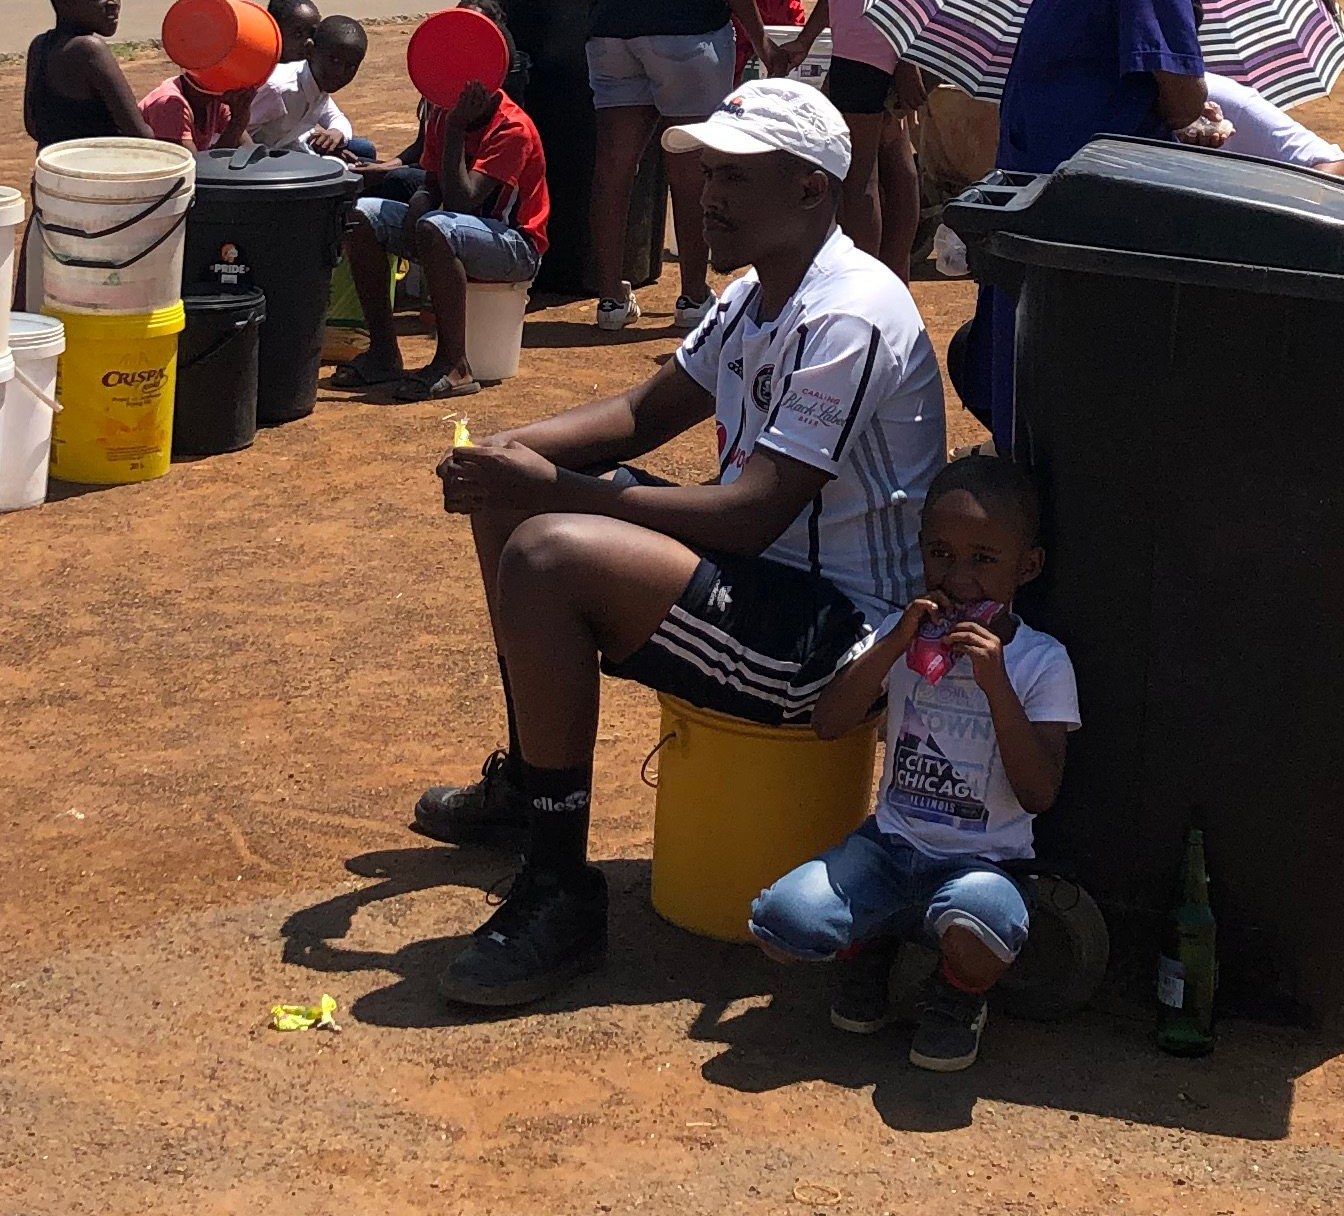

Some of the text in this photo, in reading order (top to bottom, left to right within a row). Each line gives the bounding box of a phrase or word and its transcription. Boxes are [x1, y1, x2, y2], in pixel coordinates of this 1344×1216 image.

[214, 263, 246, 274] PRIDE
[781, 390, 818, 416] Black
[801, 388, 840, 405] CARLING
[906, 755, 950, 775] CITY
[909, 795, 956, 814] ILLINOIS
